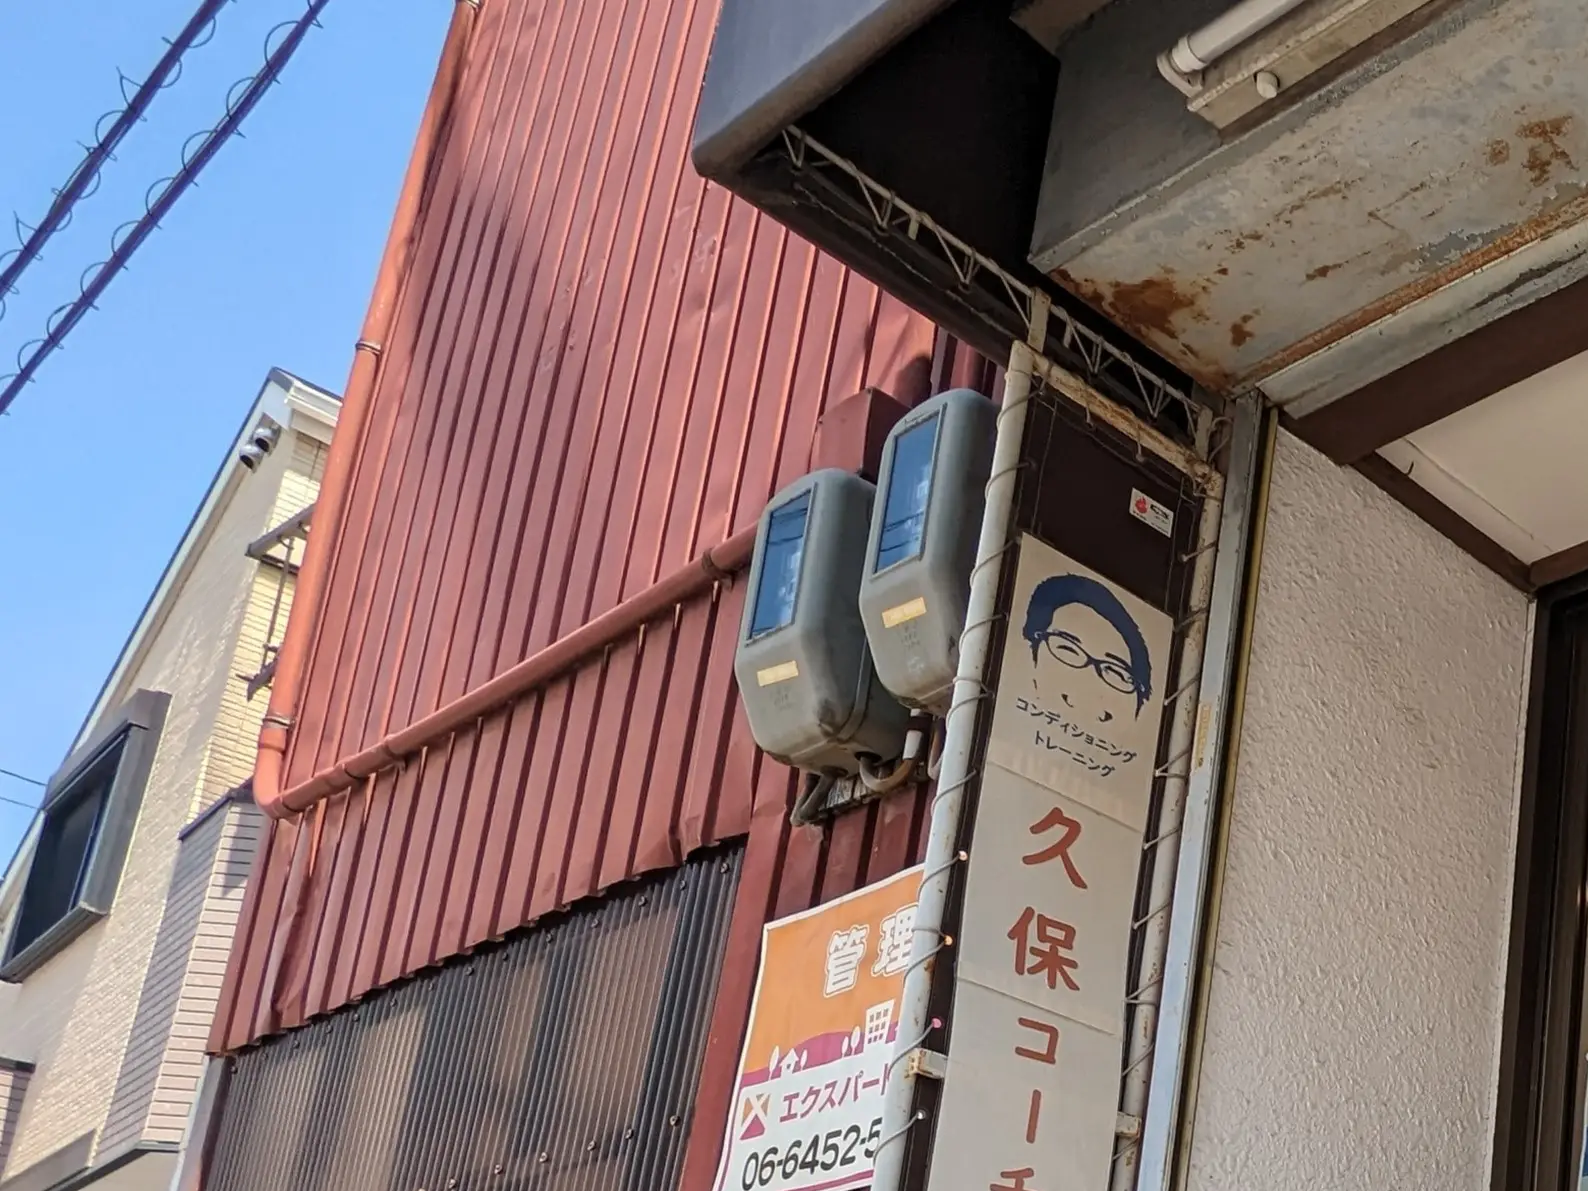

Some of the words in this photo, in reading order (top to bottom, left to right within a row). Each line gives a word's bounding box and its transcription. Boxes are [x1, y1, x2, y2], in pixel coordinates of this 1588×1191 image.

[1016, 697, 1138, 764] コンディショニング
[1034, 729, 1116, 778] トレーニング
[779, 1063, 891, 1124] エクスパート
